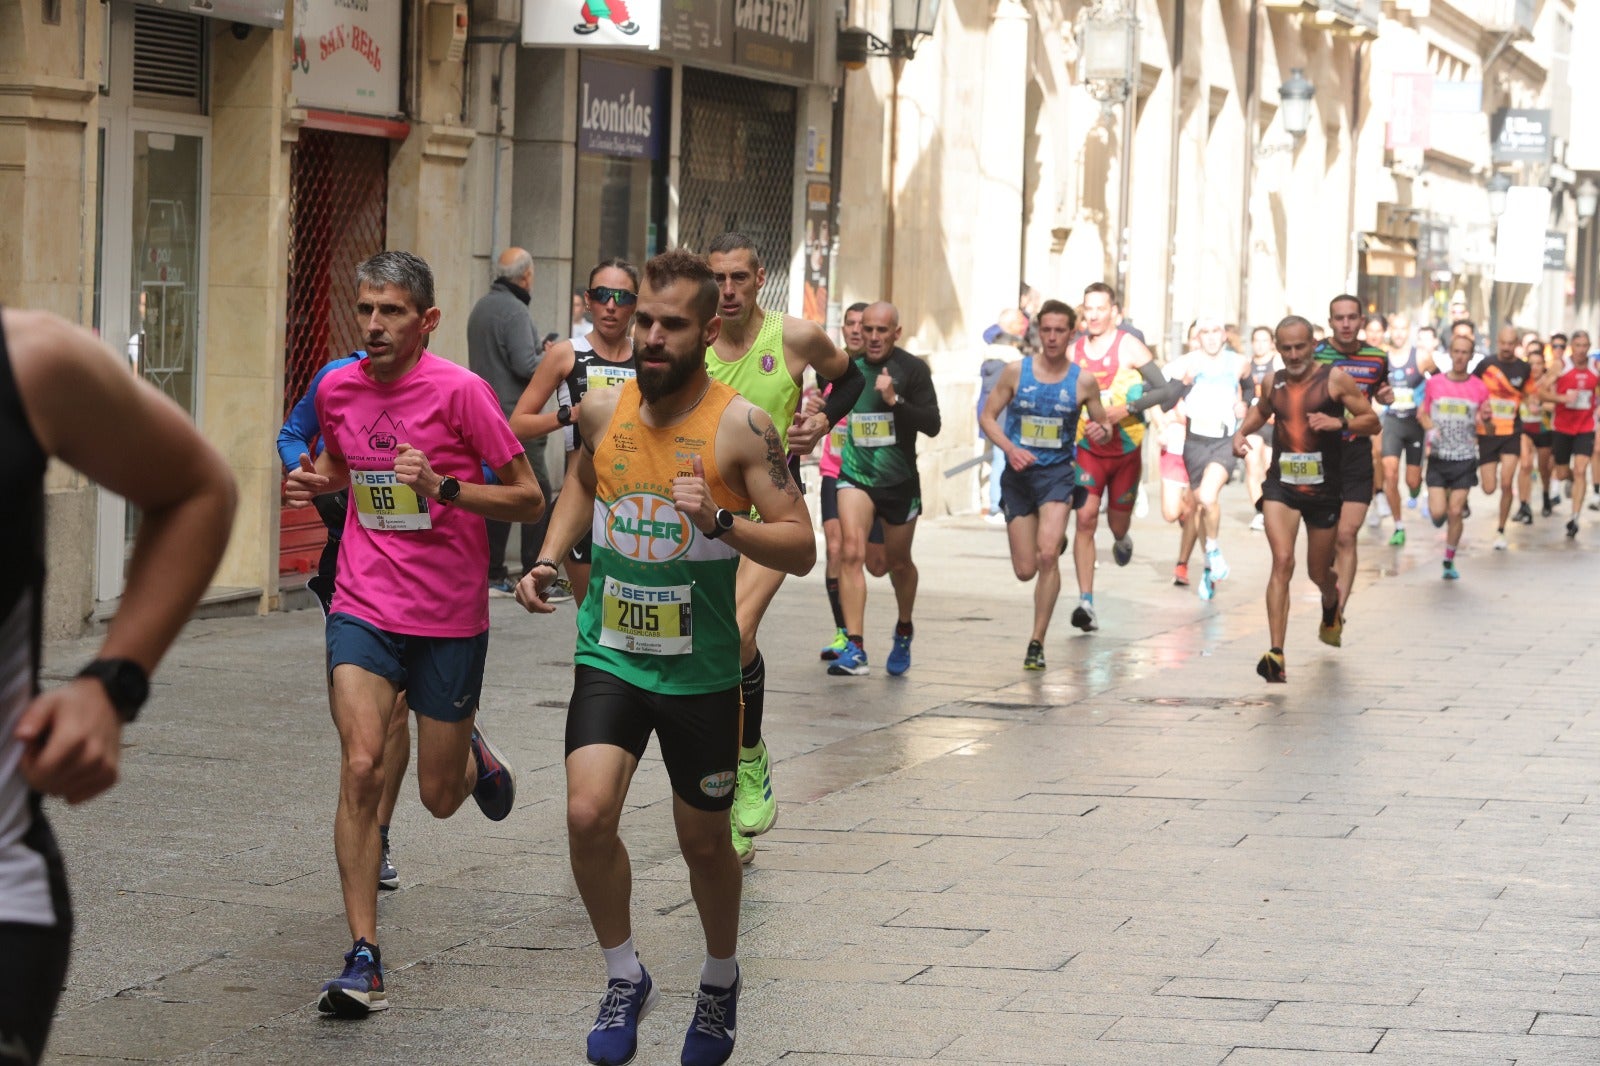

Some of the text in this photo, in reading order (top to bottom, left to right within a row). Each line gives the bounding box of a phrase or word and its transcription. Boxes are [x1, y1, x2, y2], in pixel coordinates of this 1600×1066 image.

[319, 24, 345, 61] SAN
[582, 82, 652, 138] Leonidas
[861, 422, 879, 436] 182
[1034, 425, 1044, 437] 71
[1290, 462, 1307, 474] 158
[365, 474, 396, 484] SET
[635, 482, 671, 495] DEPOR
[369, 486, 395, 510] 66
[611, 515, 683, 545] ALCER
[621, 586, 682, 602] SETEL
[618, 600, 659, 631] 205
